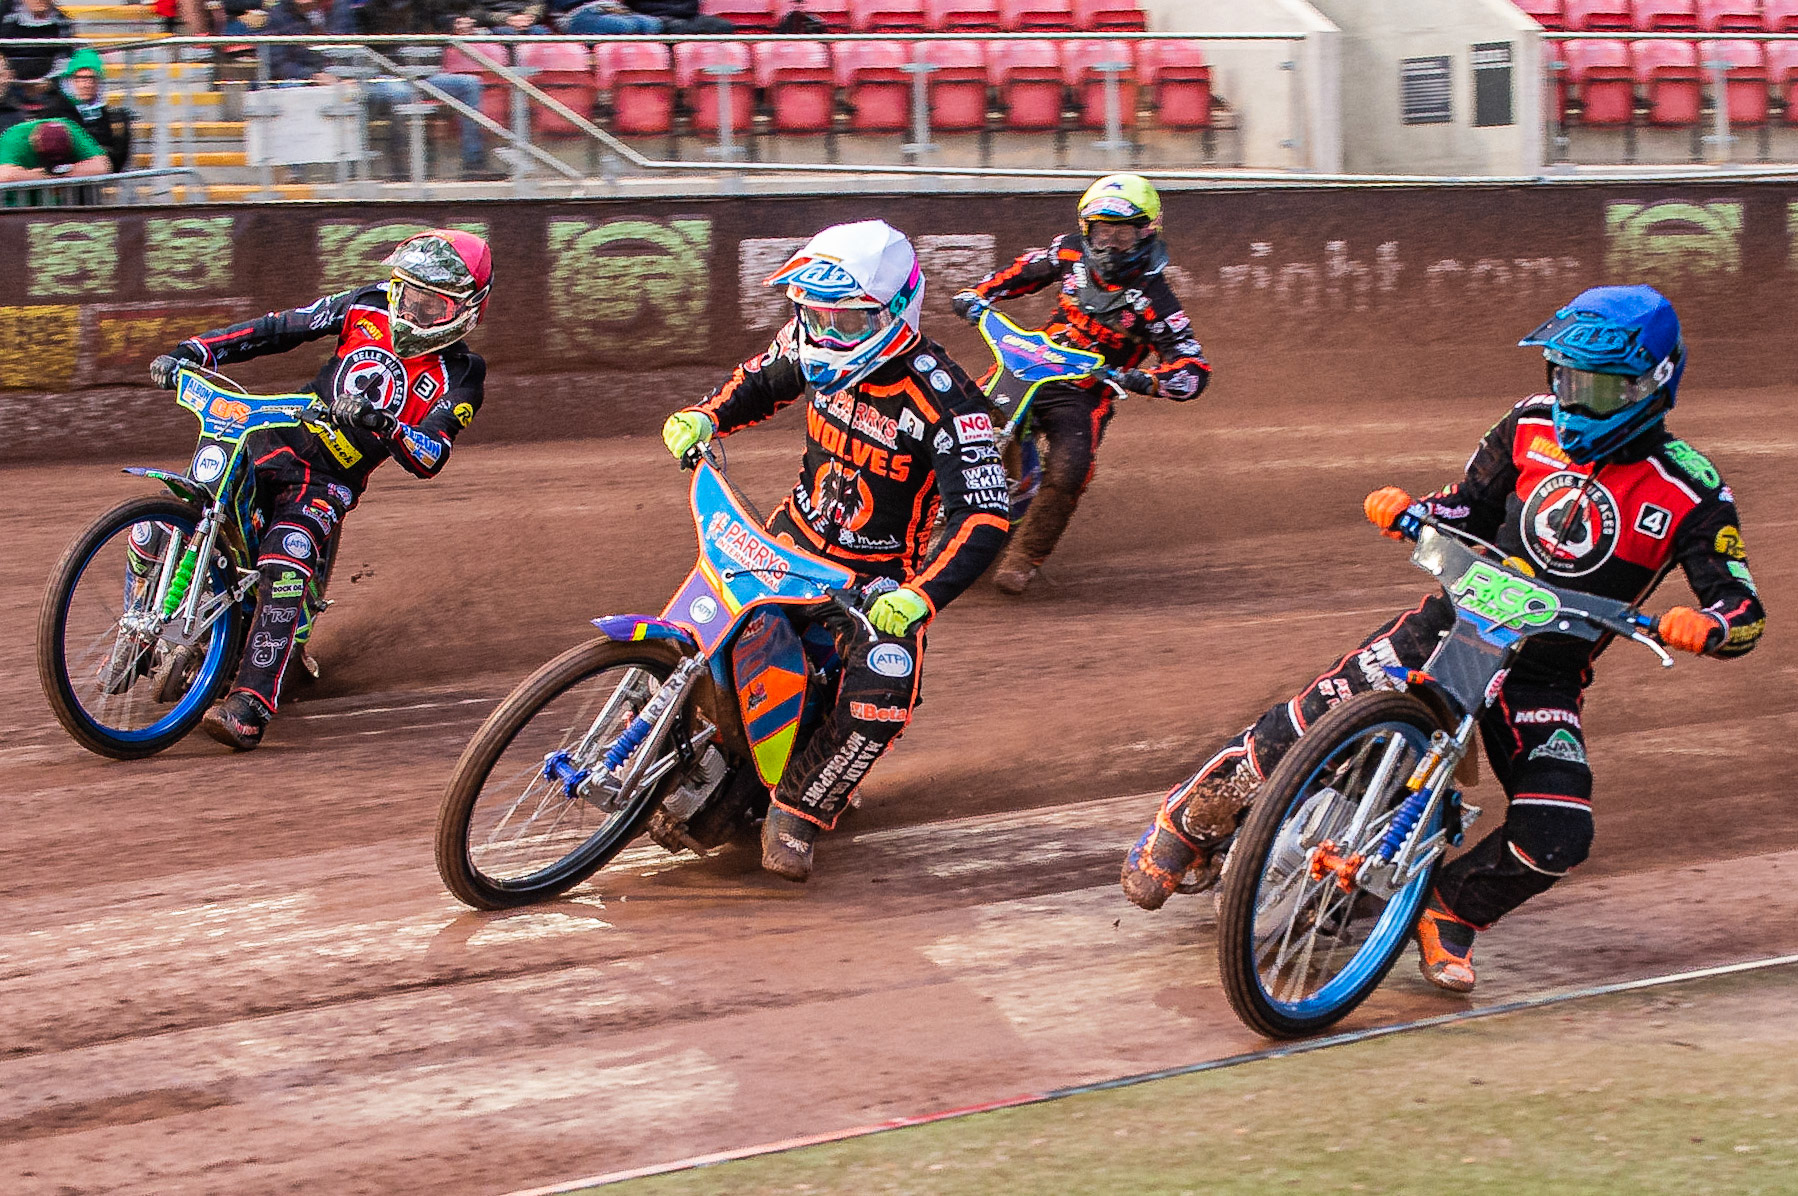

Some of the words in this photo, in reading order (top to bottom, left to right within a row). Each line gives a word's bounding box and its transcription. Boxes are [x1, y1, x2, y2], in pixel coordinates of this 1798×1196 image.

[352, 350, 382, 363] BELLE
[385, 356, 402, 374] VUE
[392, 378, 404, 406] ACES
[419, 376, 434, 398] 3
[832, 388, 898, 440] PARRYS
[807, 401, 913, 482] WOLVES
[200, 458, 220, 471] ATPI
[1642, 510, 1664, 533] 4
[724, 523, 789, 580] PARRYS
[876, 653, 907, 667] ATPI
[864, 703, 908, 721] Beta
